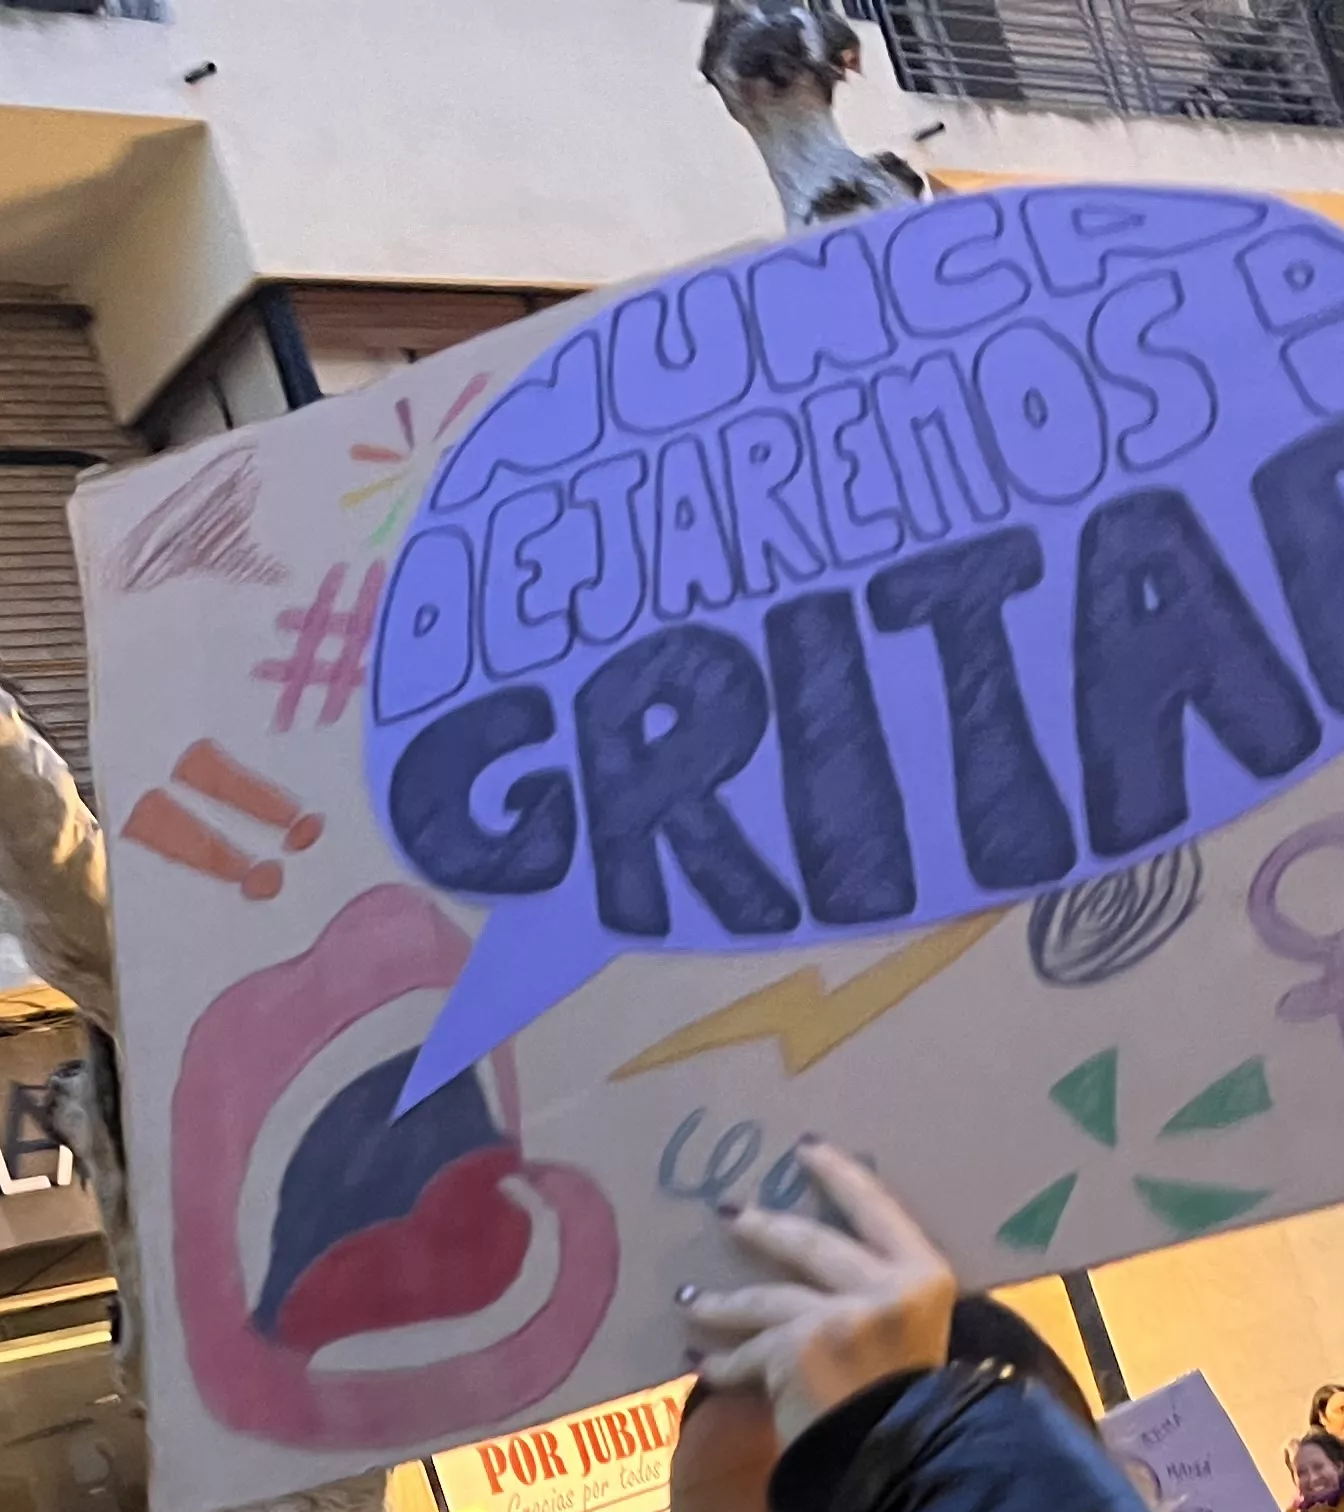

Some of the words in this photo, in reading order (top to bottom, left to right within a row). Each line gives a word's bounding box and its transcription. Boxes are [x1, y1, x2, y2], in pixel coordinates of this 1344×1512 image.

[431, 188, 1268, 512] NUNCA
[373, 268, 1220, 726] DEJAREMOS
[476, 1432, 567, 1496] POR
[619, 1454, 663, 1492] todos
